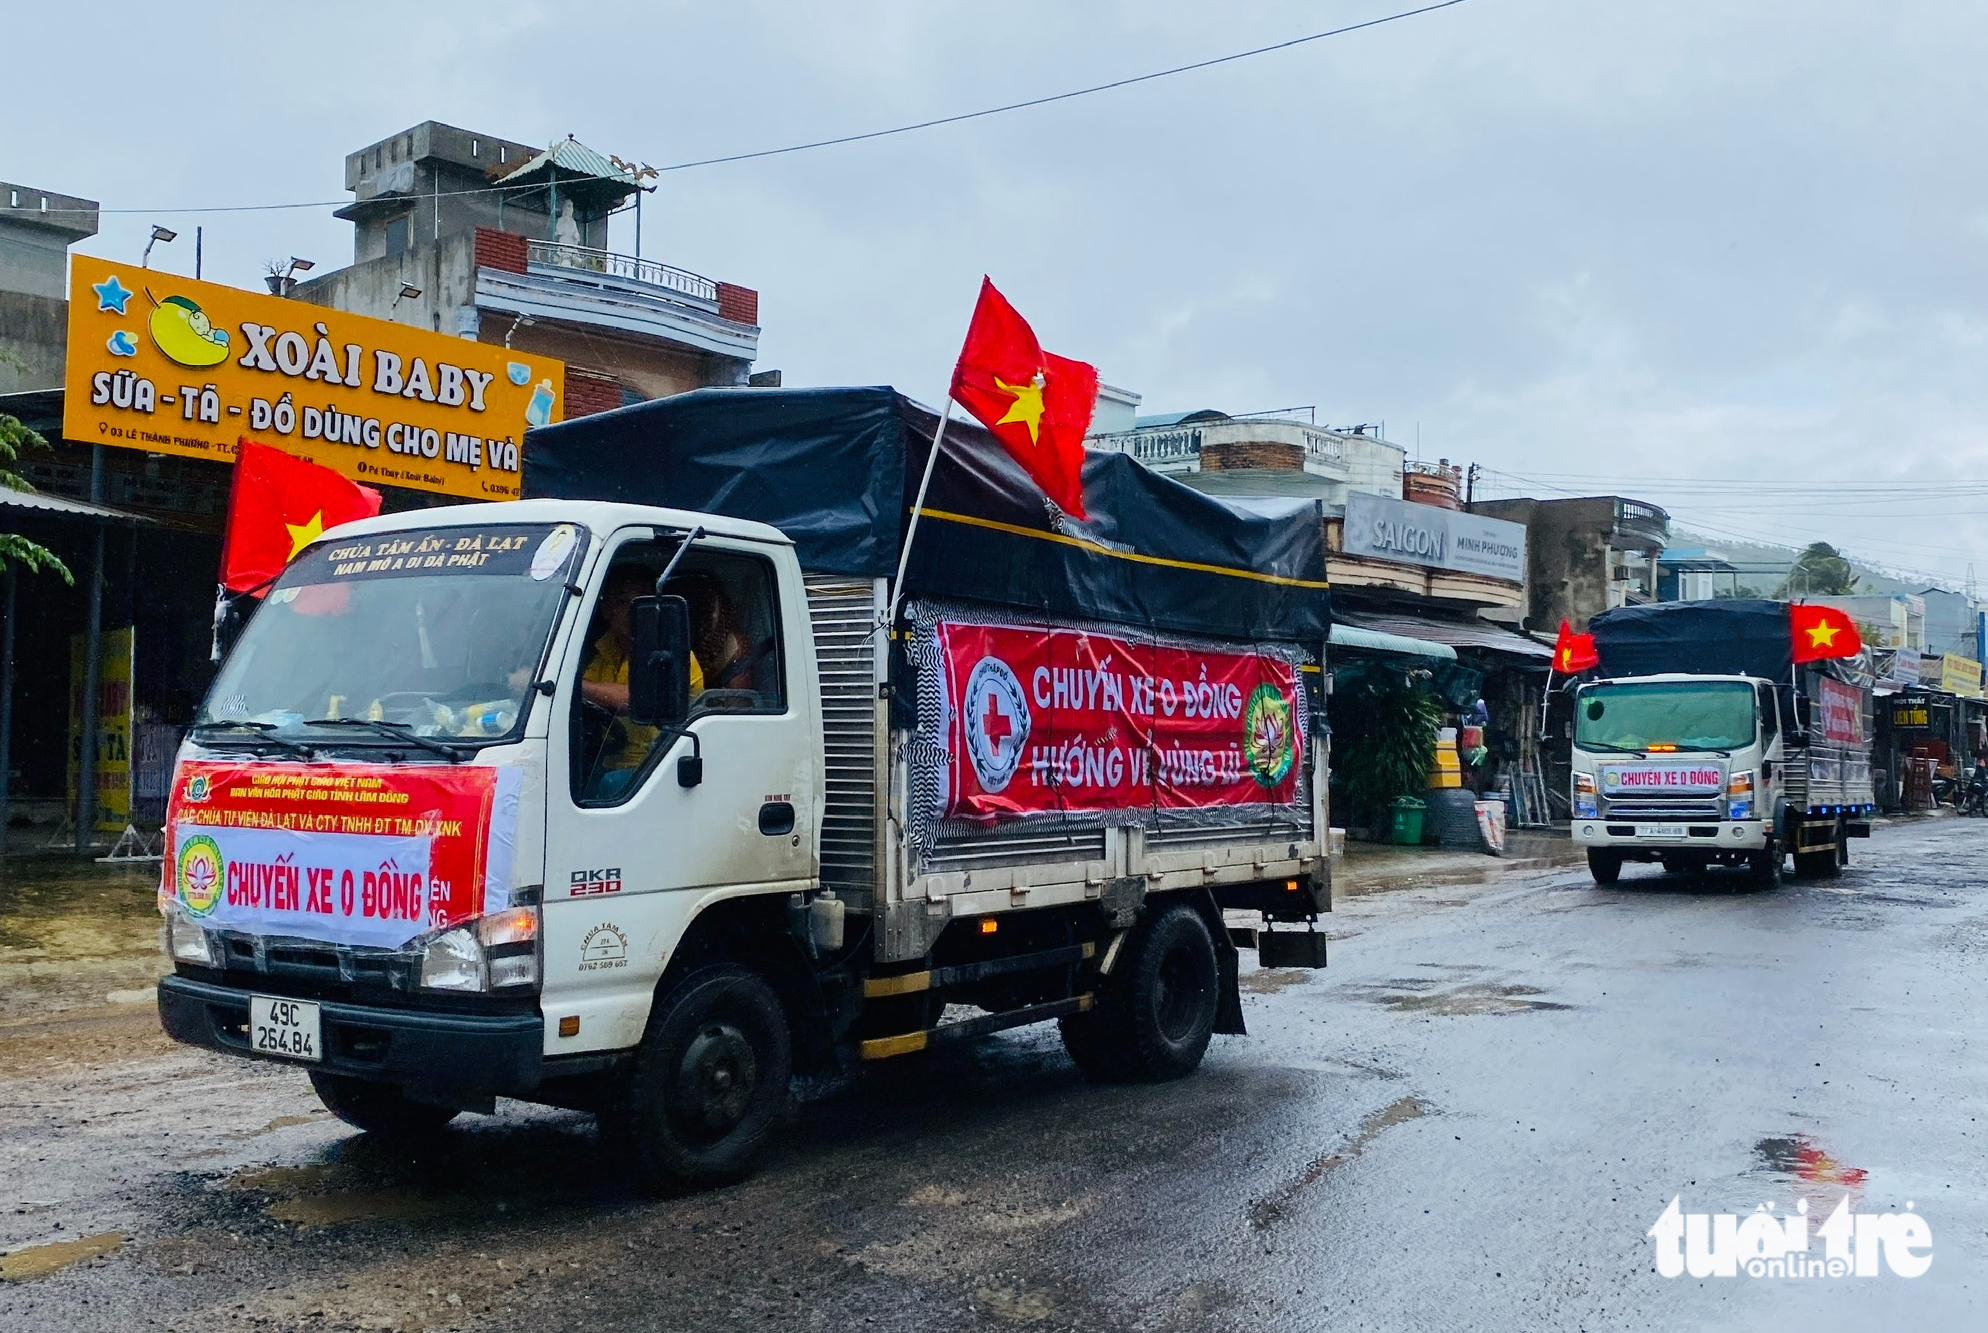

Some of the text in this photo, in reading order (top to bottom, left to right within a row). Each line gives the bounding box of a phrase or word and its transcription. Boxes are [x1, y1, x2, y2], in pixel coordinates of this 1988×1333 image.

[239, 322, 494, 412] XOÀI BABY
[92, 369, 155, 414] SỮA
[180, 383, 220, 423] TÃ
[252, 392, 296, 434] ĐỒ
[303, 404, 381, 449] DÙNG
[386, 422, 440, 458] CHO
[446, 432, 482, 472] MẸ
[487, 437, 519, 472] VÀ
[110, 427, 123, 437] 03
[328, 543, 371, 561] CHÙA
[376, 538, 415, 556] TÂM
[454, 533, 483, 551] ĐÀ
[485, 536, 528, 553] LẠT
[1372, 518, 1445, 560] SAIGON
[1457, 536, 1481, 552] MINH
[333, 561, 367, 576] NAM
[367, 556, 392, 572] MÔ
[391, 558, 402, 570] A
[446, 551, 490, 569] PHẬT
[1032, 653, 1123, 712] CHUYẾN
[1129, 675, 1155, 715] XE
[1183, 662, 1243, 719] ĐỒNG
[1031, 733, 1124, 788] HƯỚNG
[358, 777, 383, 788] NAM
[1664, 771, 1677, 785] XE
[196, 806, 221, 825] CHÙA
[299, 809, 313, 830] VÀ
[315, 814, 338, 831] CTY
[340, 816, 372, 833] TNHH
[375, 817, 391, 834] ĐT
[394, 818, 412, 834] TM
[227, 852, 299, 911] CHUYẾN
[305, 866, 334, 914] XE
[361, 857, 422, 922] ĐỒNG
[570, 880, 621, 896] 230
[571, 867, 621, 883] QKR
[269, 1001, 300, 1027] 49C
[258, 1025, 313, 1056] 264.84
